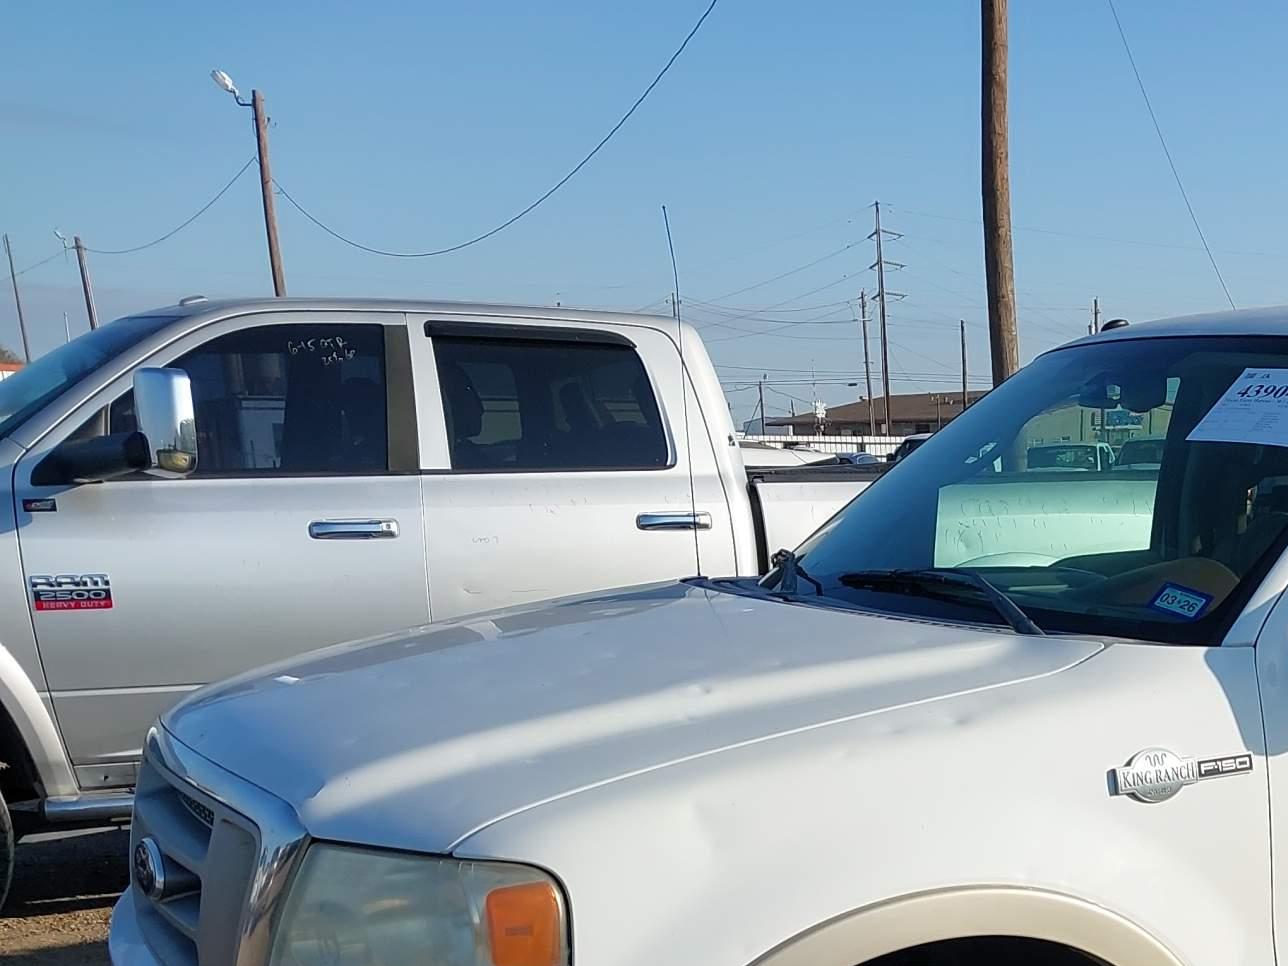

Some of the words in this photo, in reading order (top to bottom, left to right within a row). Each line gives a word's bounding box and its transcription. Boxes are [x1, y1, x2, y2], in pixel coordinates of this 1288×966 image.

[29, 574, 110, 588] RAM
[40, 590, 105, 600] 2500
[43, 600, 76, 609] HEAVY
[80, 600, 106, 608] DUTY
[1122, 769, 1153, 788] KING
[1154, 761, 1195, 784] RANCH
